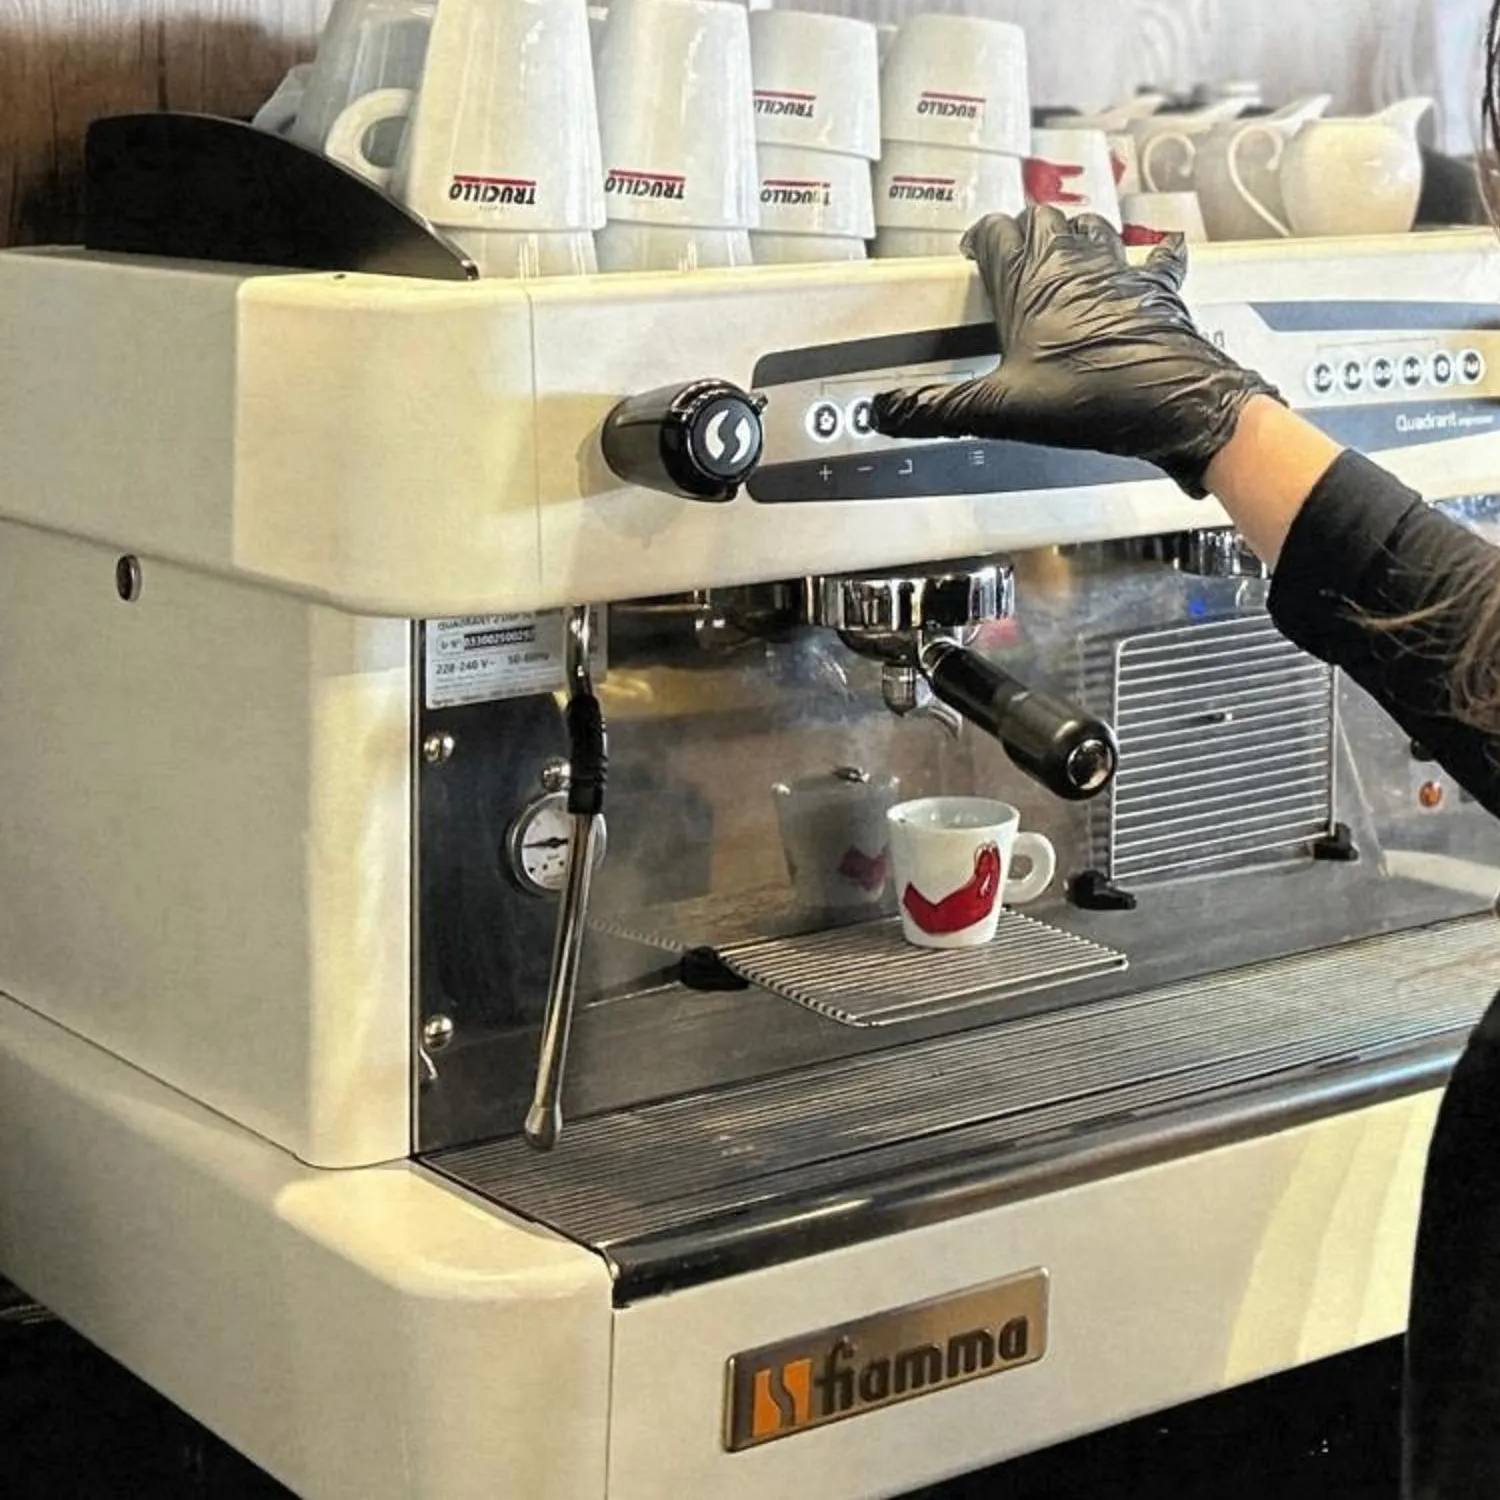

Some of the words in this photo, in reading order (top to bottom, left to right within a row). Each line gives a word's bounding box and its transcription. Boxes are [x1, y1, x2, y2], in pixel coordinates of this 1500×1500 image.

[752, 99, 814, 118] TRUCILL
[916, 99, 979, 119] RUCILLO
[448, 182, 536, 205] TRUCILLO
[604, 177, 686, 200] TRUCILLO
[888, 184, 955, 201] TRUCILLO
[1396, 411, 1456, 432] Quadrant
[815, 1315, 1029, 1416] fiamma
